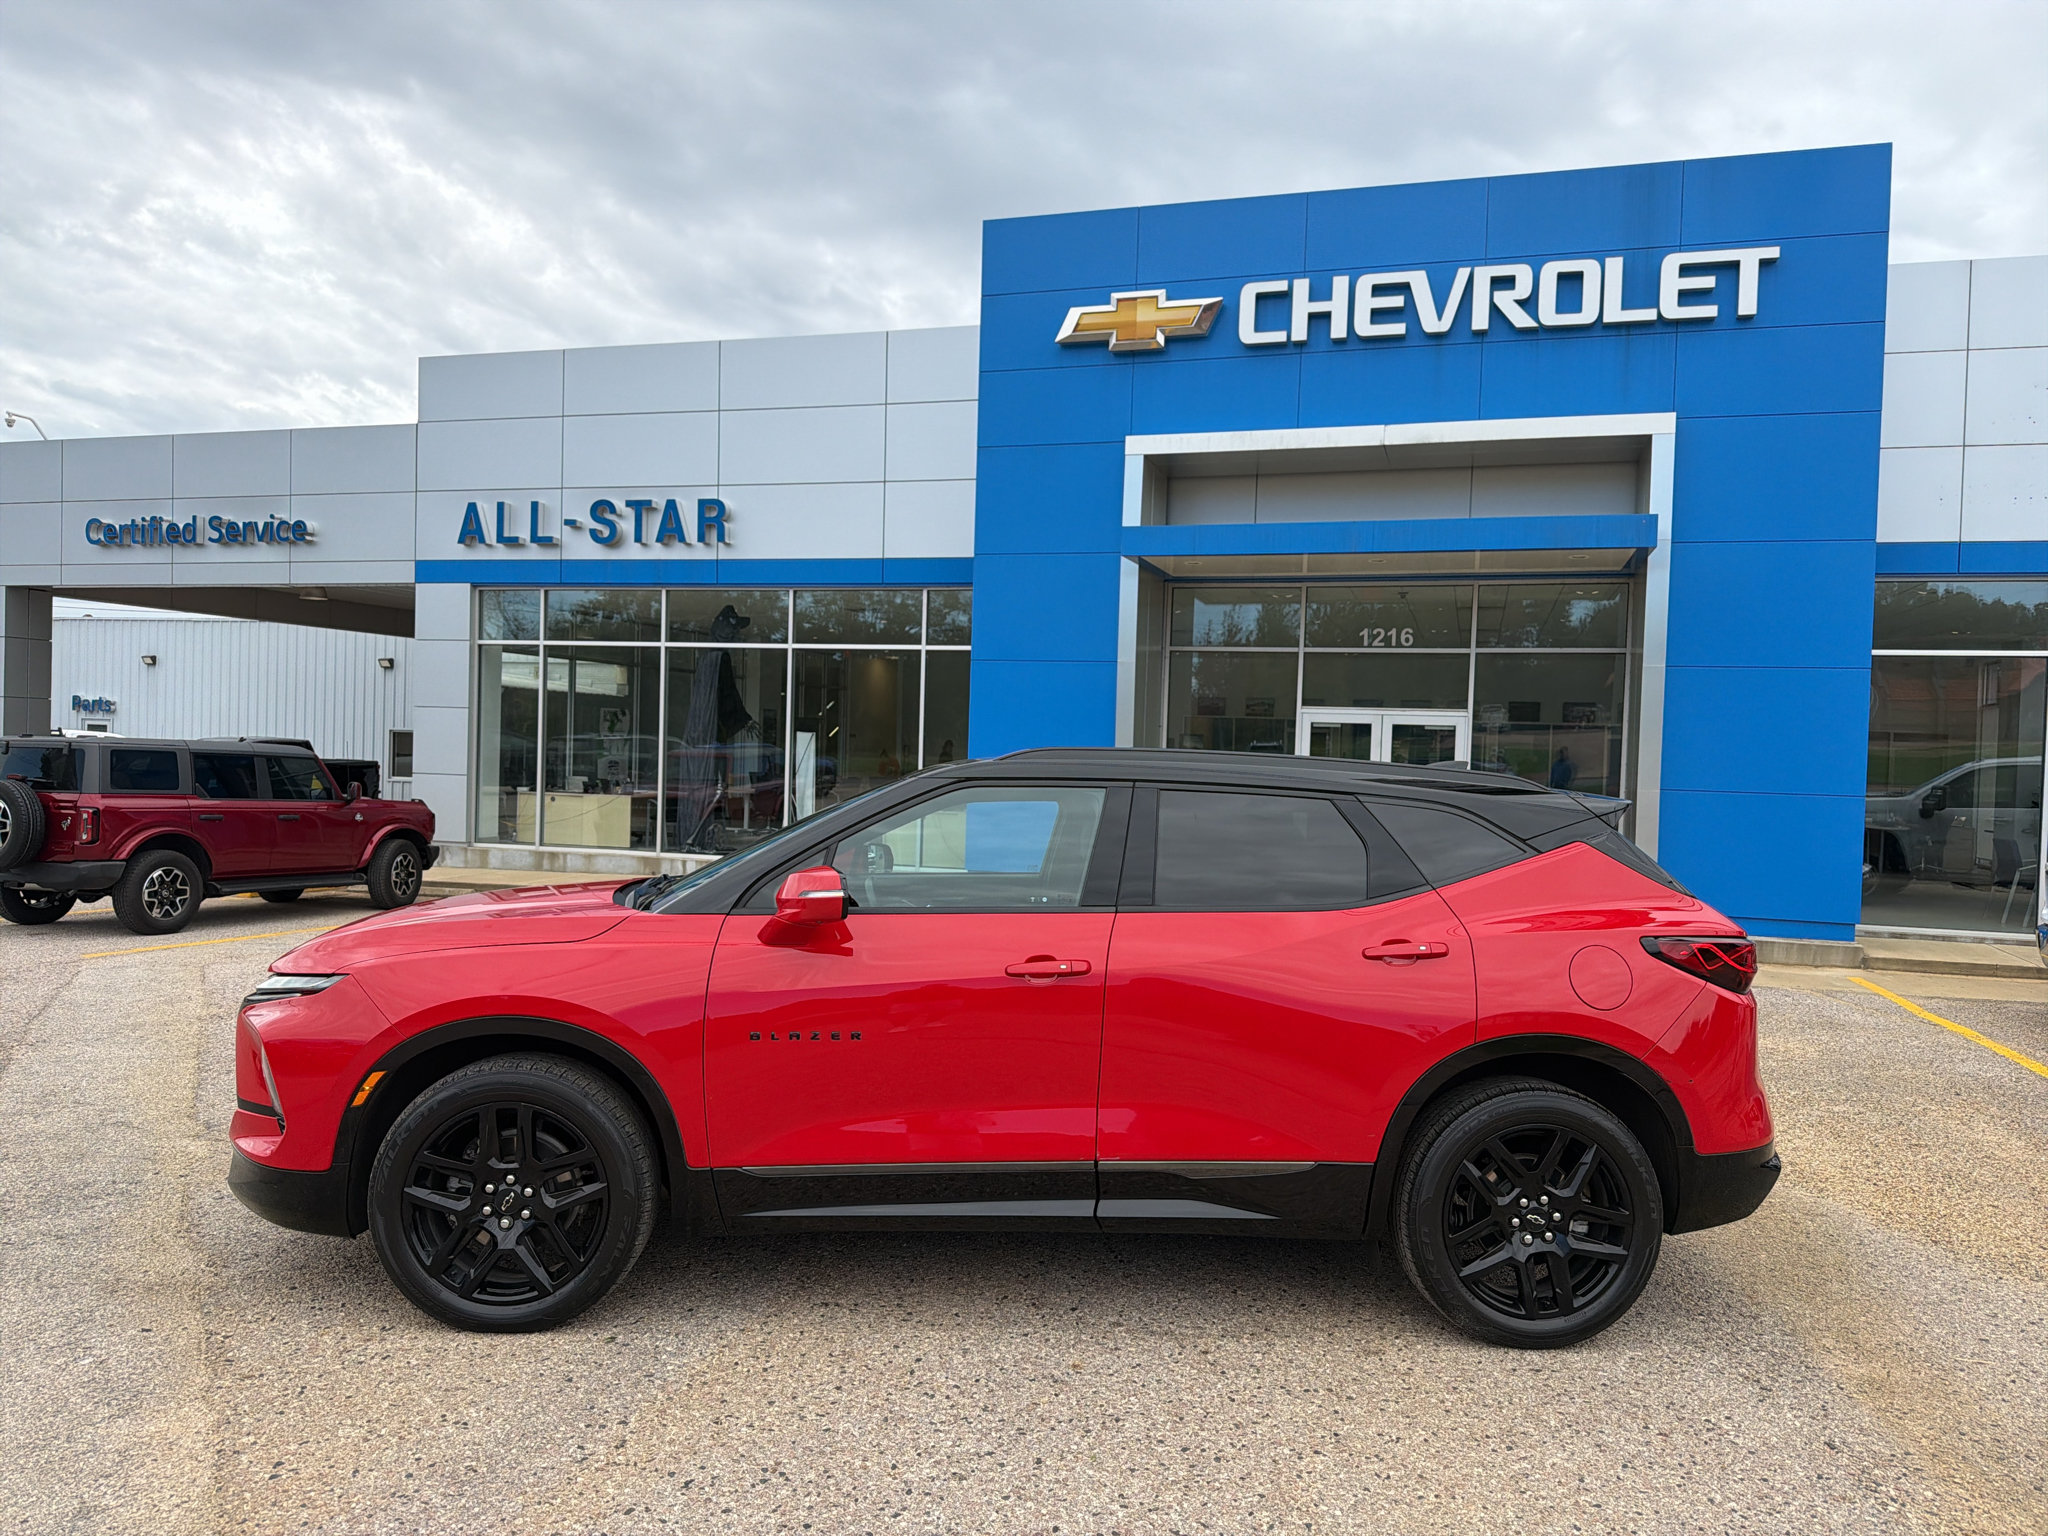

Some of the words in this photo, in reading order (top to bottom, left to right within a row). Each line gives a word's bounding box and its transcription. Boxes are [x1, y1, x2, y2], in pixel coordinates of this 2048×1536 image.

[1238, 246, 1781, 346] CHEVROLET
[85, 514, 200, 545] Certified
[207, 513, 308, 543] Service
[457, 498, 728, 545] ALL-STAR
[1359, 627, 1415, 647] 1216
[72, 695, 113, 713] Parts
[749, 1031, 862, 1041] BLAZER
